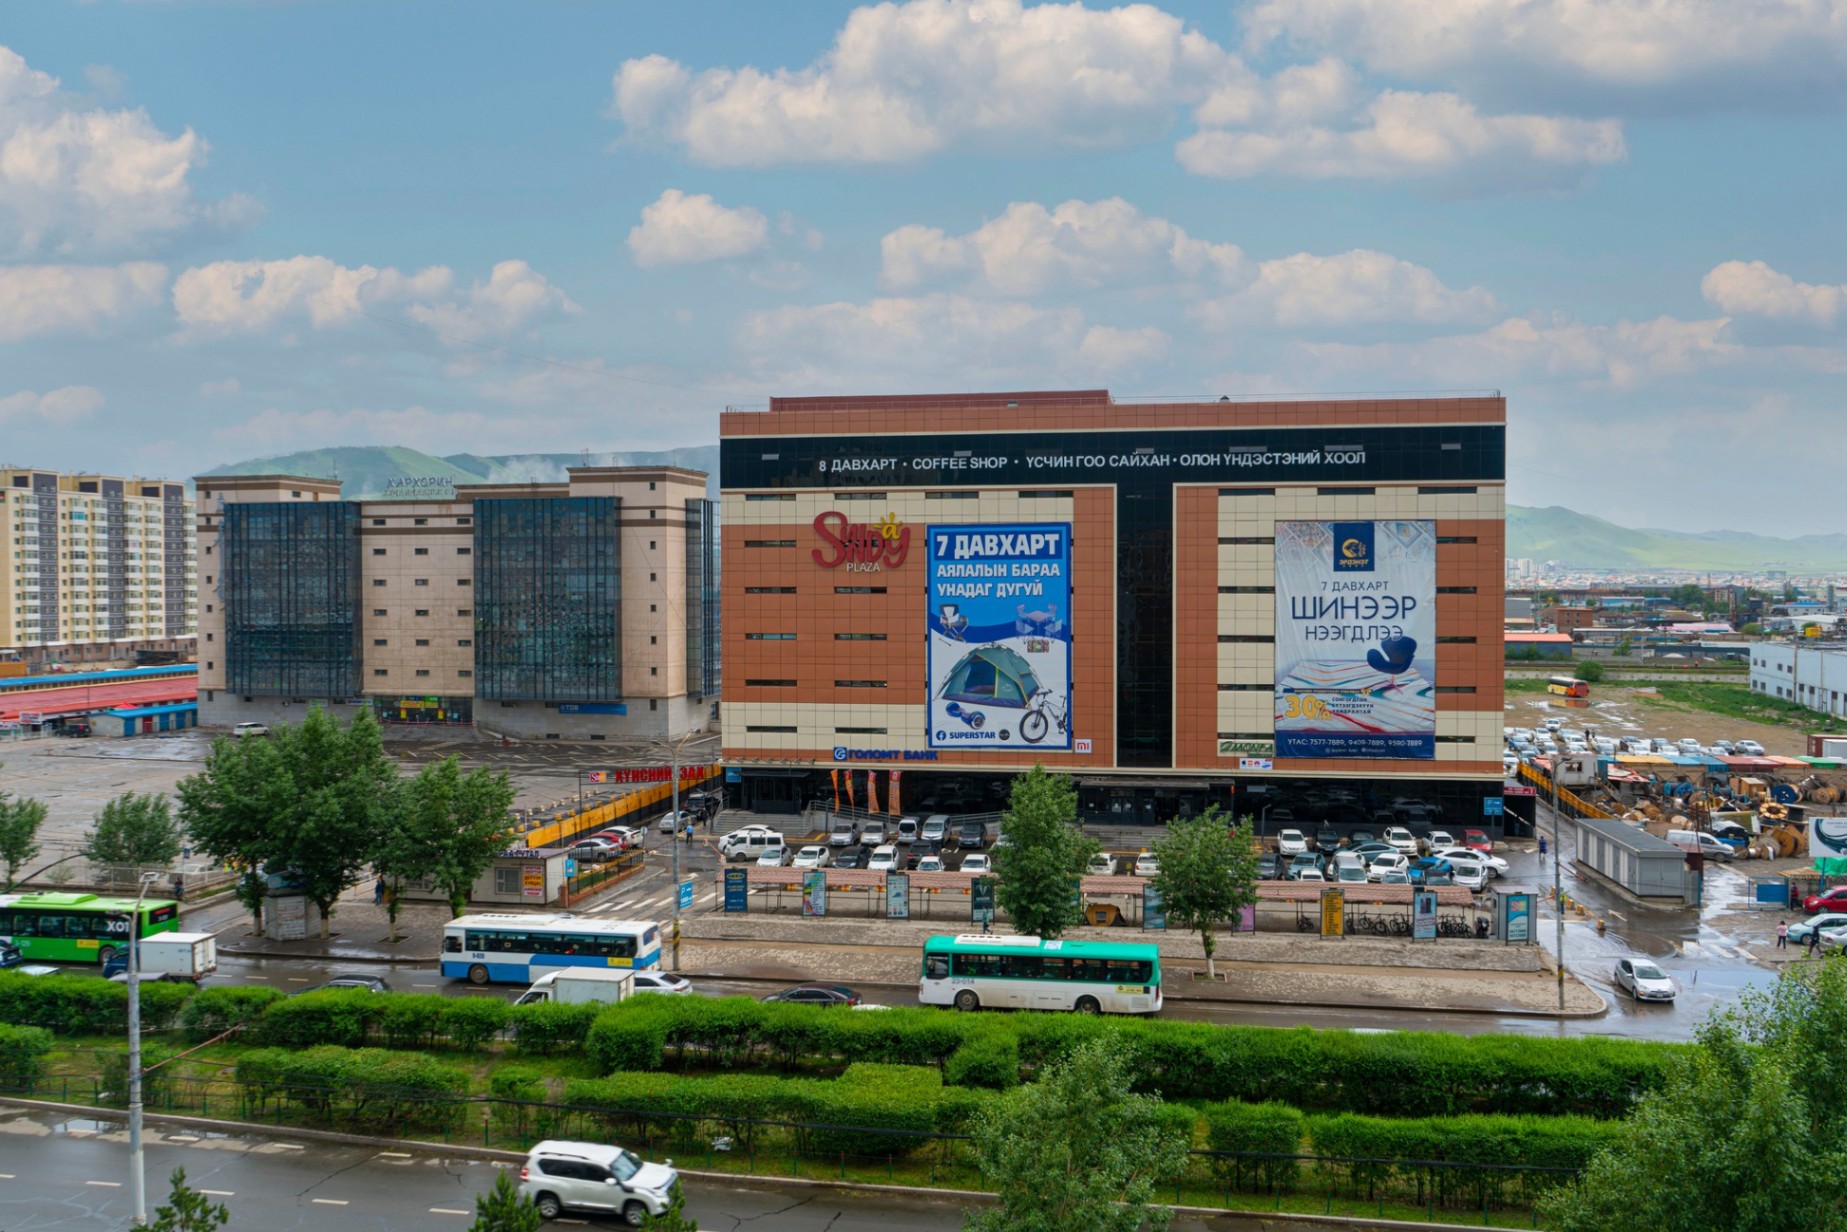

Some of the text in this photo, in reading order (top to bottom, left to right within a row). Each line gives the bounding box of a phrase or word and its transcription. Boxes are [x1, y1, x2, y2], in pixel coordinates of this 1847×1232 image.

[818, 449, 1366, 473] 8 ДАВХАРТ COFFEE SHOP ҮСЧИН ГОО САЙХАН ОЛОН ҮНДЭСТЭНИЙ ХООЛ
[936, 533, 1060, 560] 7 ДАВХАРТ
[846, 562, 880, 572] PLAZA
[937, 563, 1060, 578] АЯЛАЛЫН БАРАА
[937, 579, 1043, 599] УНАДАГ ДУГУЙ
[1321, 580, 1389, 592] 7 ДАВХАРТ
[1291, 595, 1417, 620] ШИНЭЭР
[1305, 625, 1404, 643] НЭЭГДЛЭЭ
[1285, 695, 1332, 721] 30%
[949, 731, 996, 739] SUPERSTAR
[848, 749, 939, 761] ГОЛОМТ БАНК
